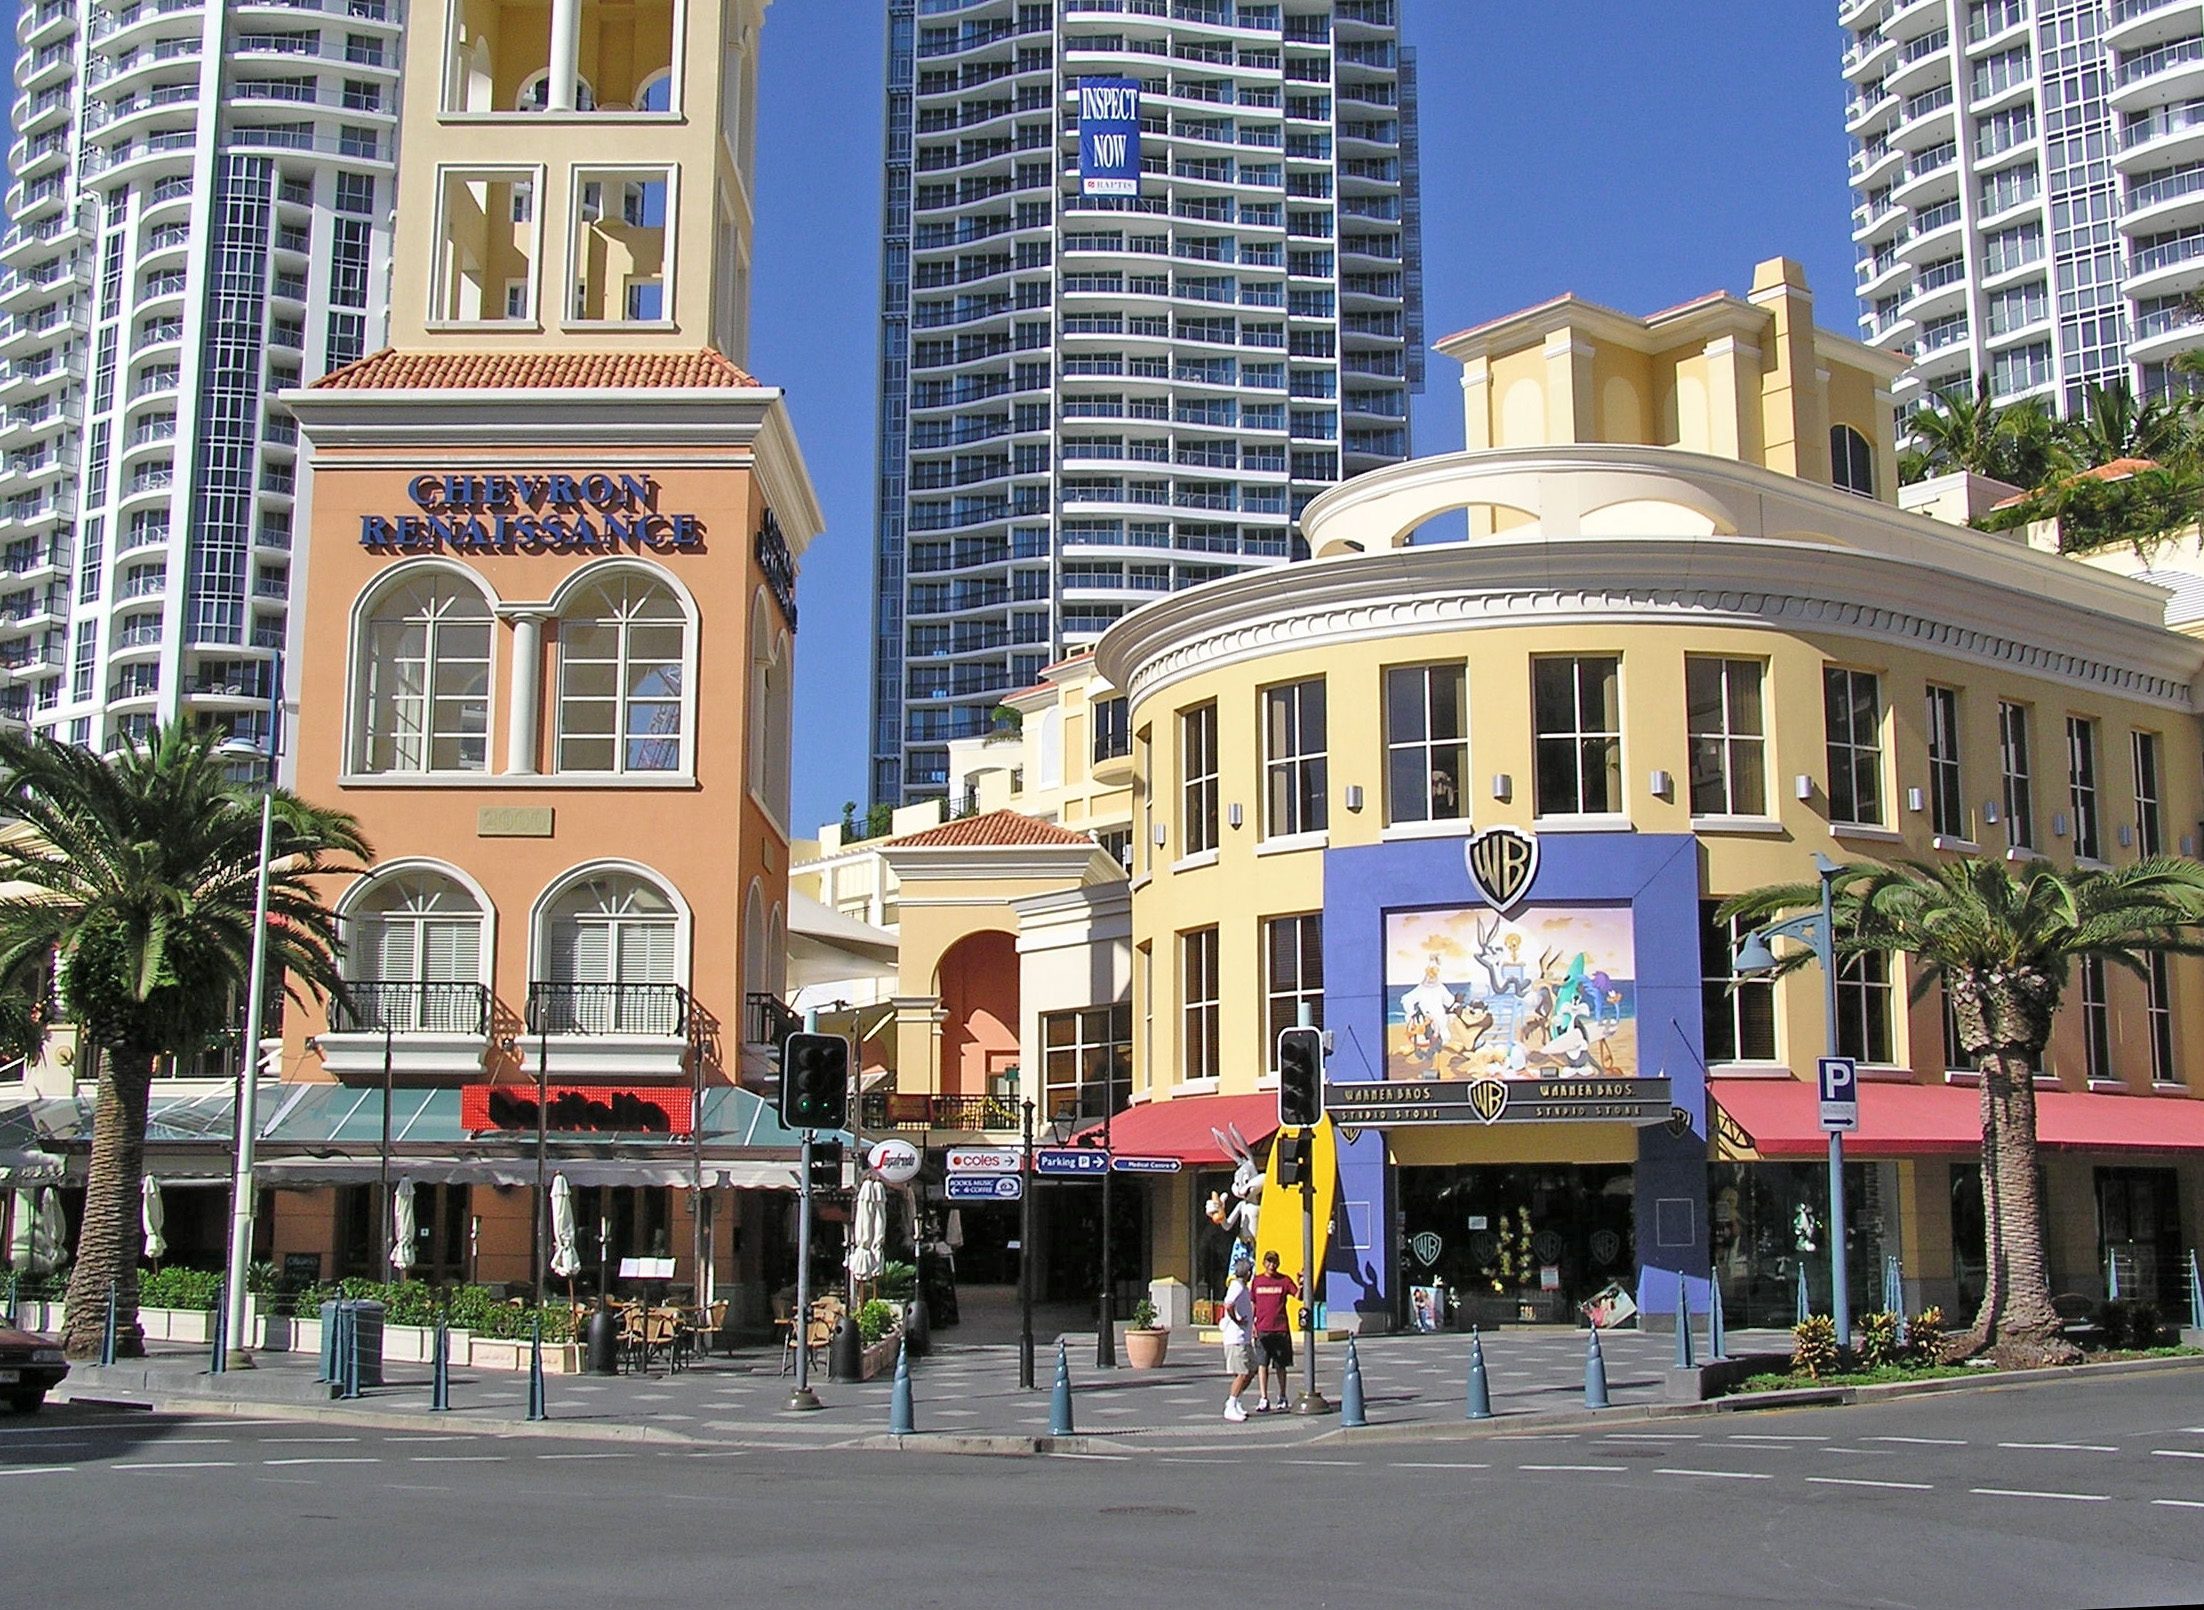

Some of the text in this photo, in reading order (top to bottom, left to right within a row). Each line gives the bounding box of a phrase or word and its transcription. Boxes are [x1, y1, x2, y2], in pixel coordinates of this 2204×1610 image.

[1082, 87, 1137, 120] INSPECT
[1093, 134, 1127, 168] NOW
[408, 474, 650, 506] CHEVRON
[359, 513, 699, 546] RENAISSANCE
[1474, 834, 1528, 898] WB
[1825, 1062, 1851, 1098] P
[1344, 1088, 1393, 1100] WARNER
[1539, 1084, 1593, 1098] WARNER
[1472, 1082, 1504, 1119] WB
[1342, 1109, 1439, 1120] STUDIO STORE
[1536, 1106, 1586, 1117] STUDIO
[963, 1154, 1000, 1167] coles
[1041, 1155, 1076, 1169] Parking
[1128, 1160, 1170, 1169] Medical Centre
[969, 1186, 993, 1194] COFFEE
